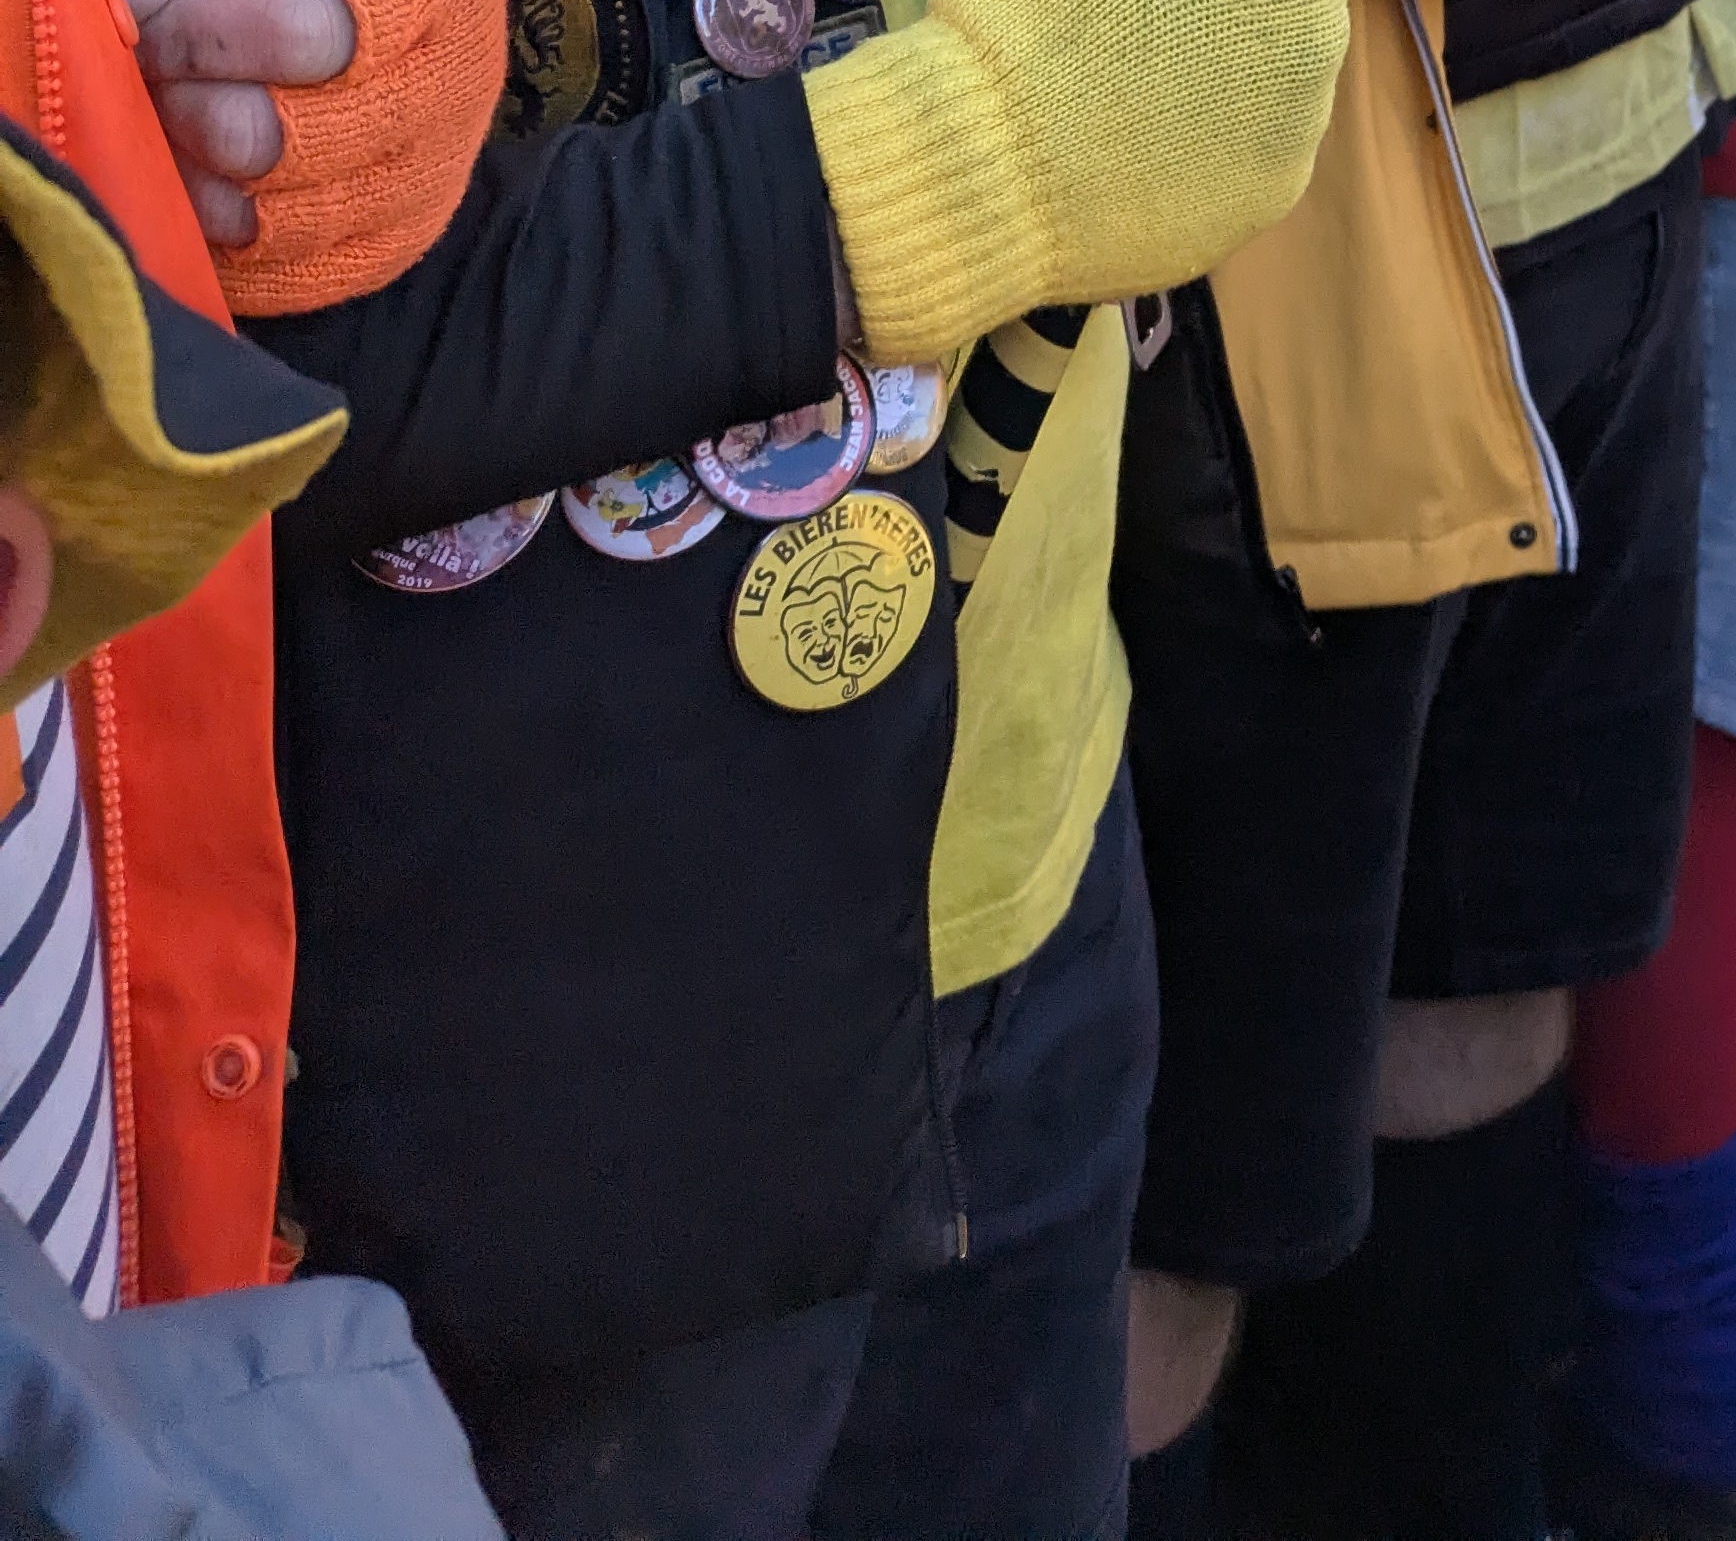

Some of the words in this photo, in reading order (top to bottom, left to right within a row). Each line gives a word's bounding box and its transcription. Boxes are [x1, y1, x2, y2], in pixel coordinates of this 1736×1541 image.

[839, 420, 865, 473] JEAN
[739, 572, 778, 618] LES
[774, 503, 934, 578] BIEREN'AERES
